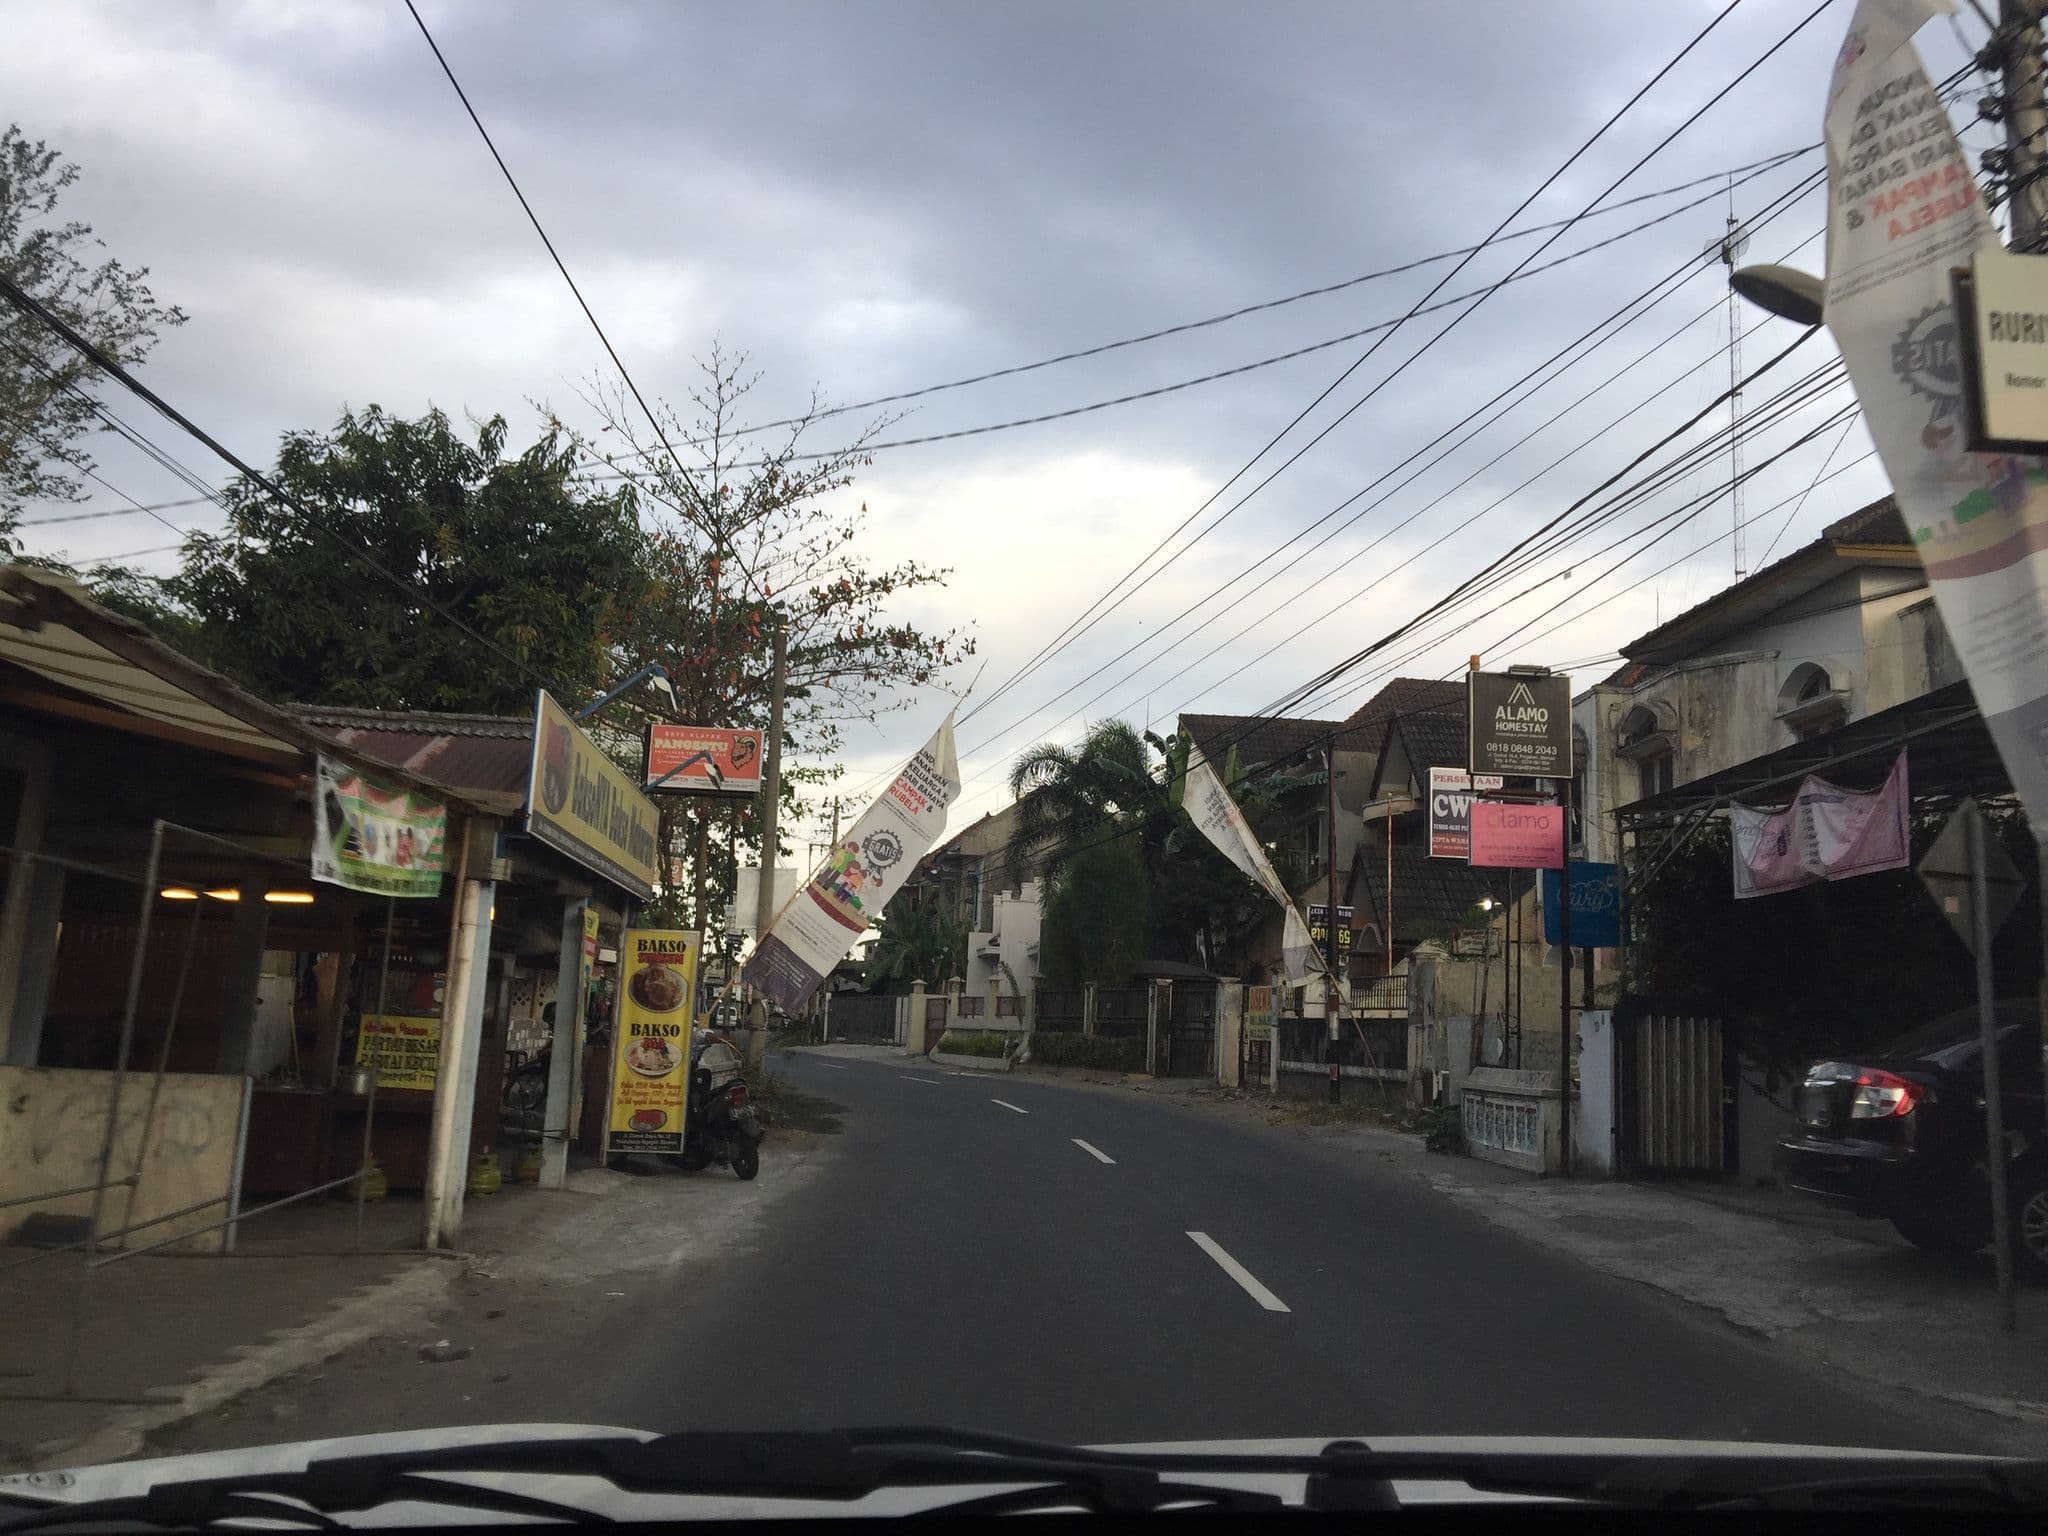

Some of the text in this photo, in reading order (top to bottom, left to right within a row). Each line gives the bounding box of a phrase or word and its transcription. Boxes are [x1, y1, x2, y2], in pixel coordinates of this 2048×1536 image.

[1495, 705, 1549, 722] ALAMO
[1495, 721, 1548, 733] HOMESTAY
[1486, 742, 1558, 755] 0818 0848 2043
[895, 778, 929, 808] CAMPAK
[902, 769, 919, 786] DARI
[917, 783, 945, 810] BAHAYA
[888, 786, 919, 815] RUBELA
[868, 840, 898, 860] GRATIS
[637, 939, 687, 953] BAKSO
[630, 1023, 681, 1037] BAKSO
